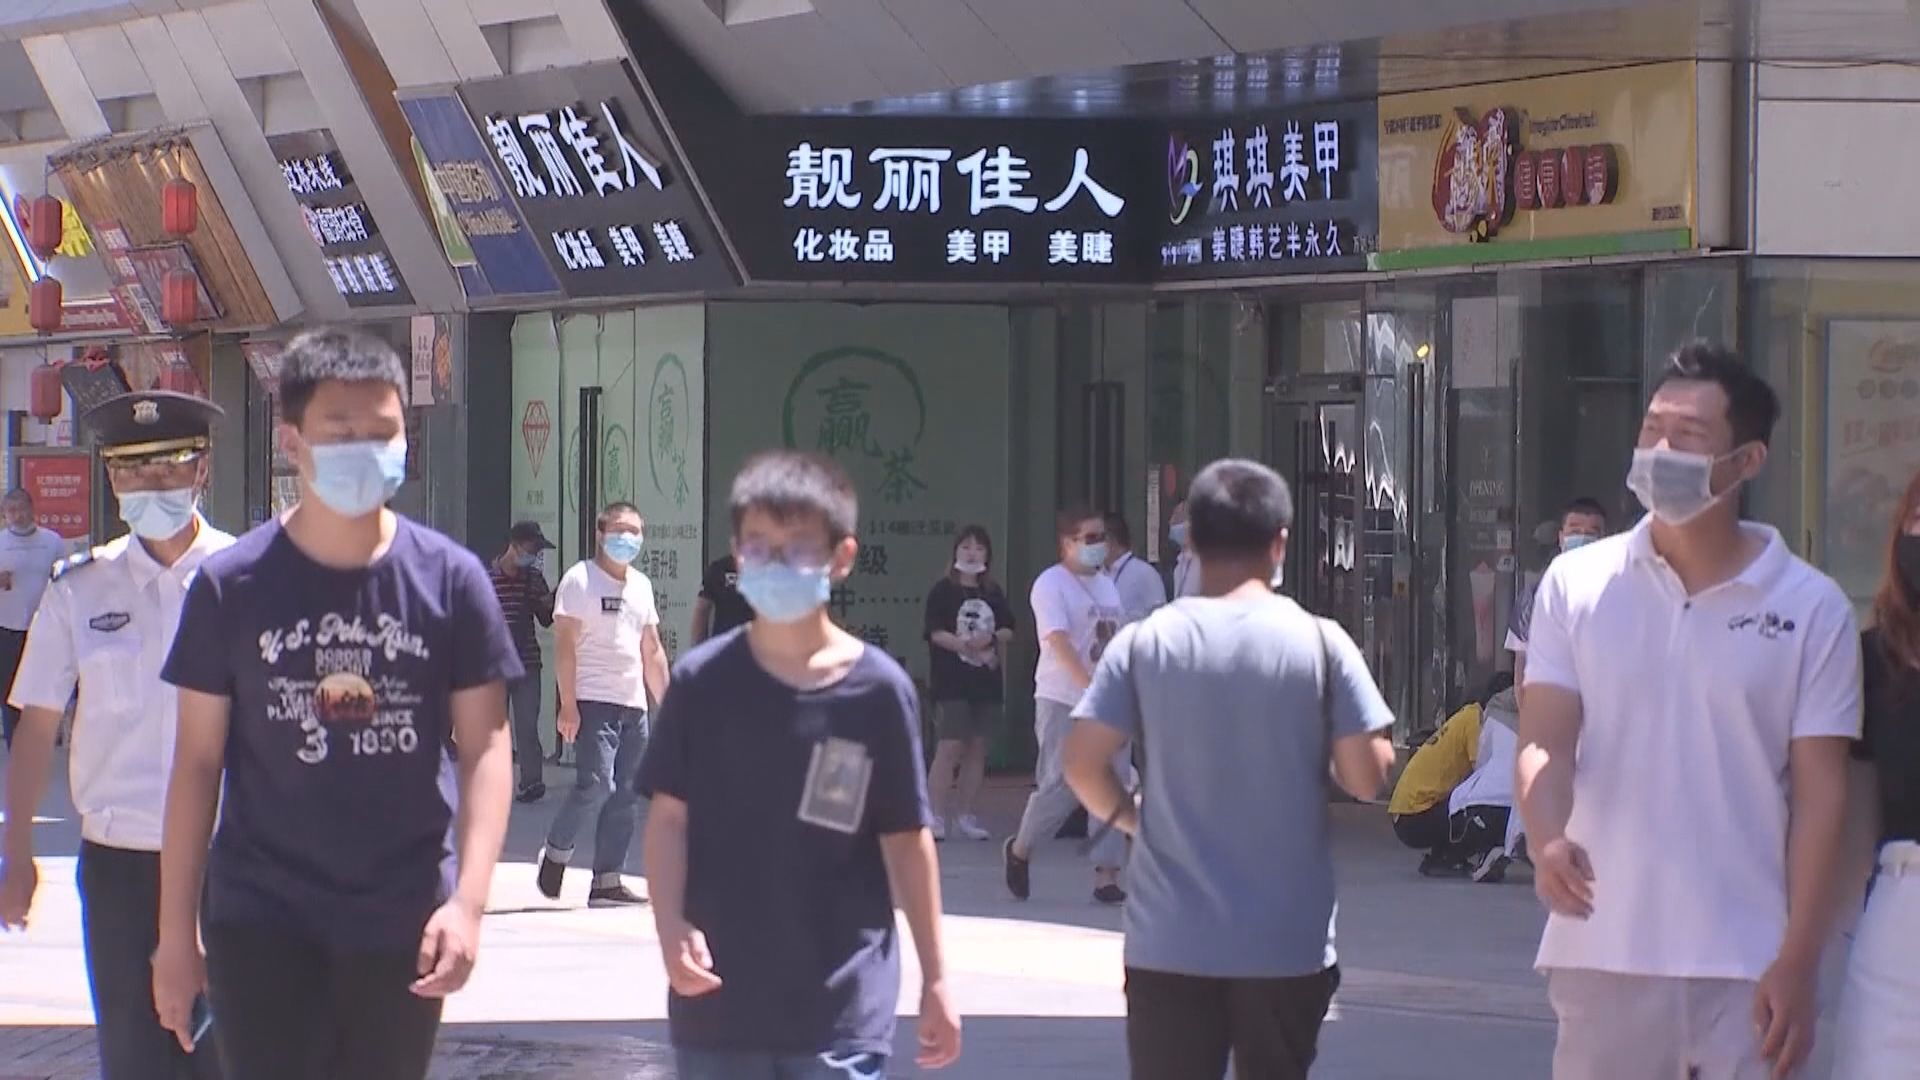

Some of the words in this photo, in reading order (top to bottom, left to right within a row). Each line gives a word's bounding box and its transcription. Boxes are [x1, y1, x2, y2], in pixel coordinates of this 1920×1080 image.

[485, 101, 663, 197] 靓丽佳人
[783, 142, 1126, 217] 靓丽佳人
[1212, 119, 1339, 212] 琪琪美甲
[551, 229, 605, 270] 化妆品
[608, 225, 646, 267] 美甲
[652, 220, 695, 263] 美睫
[793, 227, 895, 262] 化妆品
[946, 229, 1011, 263] 美甲
[1048, 230, 1114, 264] 美睫
[1211, 218, 1342, 262] 美睫韩艺半永久
